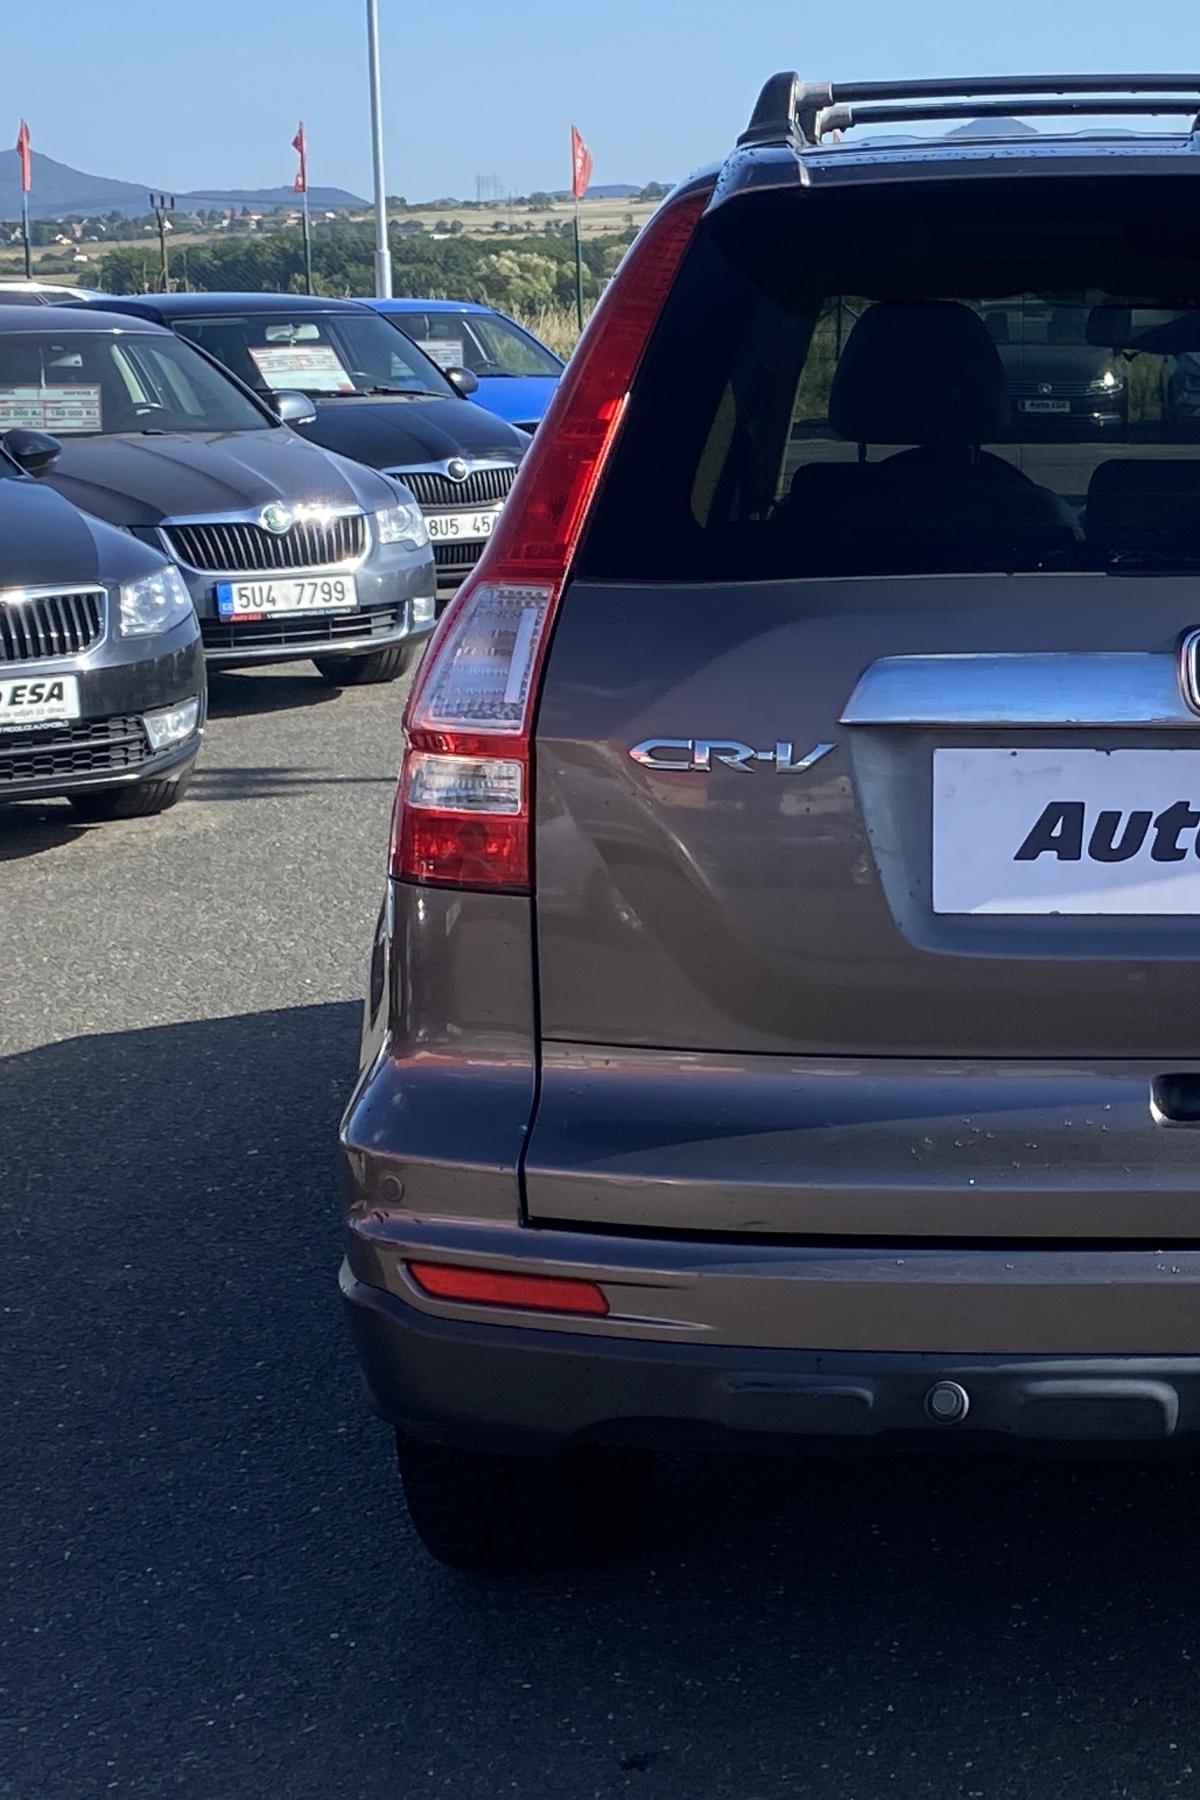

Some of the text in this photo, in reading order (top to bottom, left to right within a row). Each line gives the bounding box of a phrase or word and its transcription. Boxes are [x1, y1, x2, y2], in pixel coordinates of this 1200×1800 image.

[428, 515, 497, 537] 8U5 45
[237, 585, 276, 609] 5U4
[294, 580, 346, 606] 7799
[8, 681, 64, 706] ESA
[629, 739, 839, 774] CR-V
